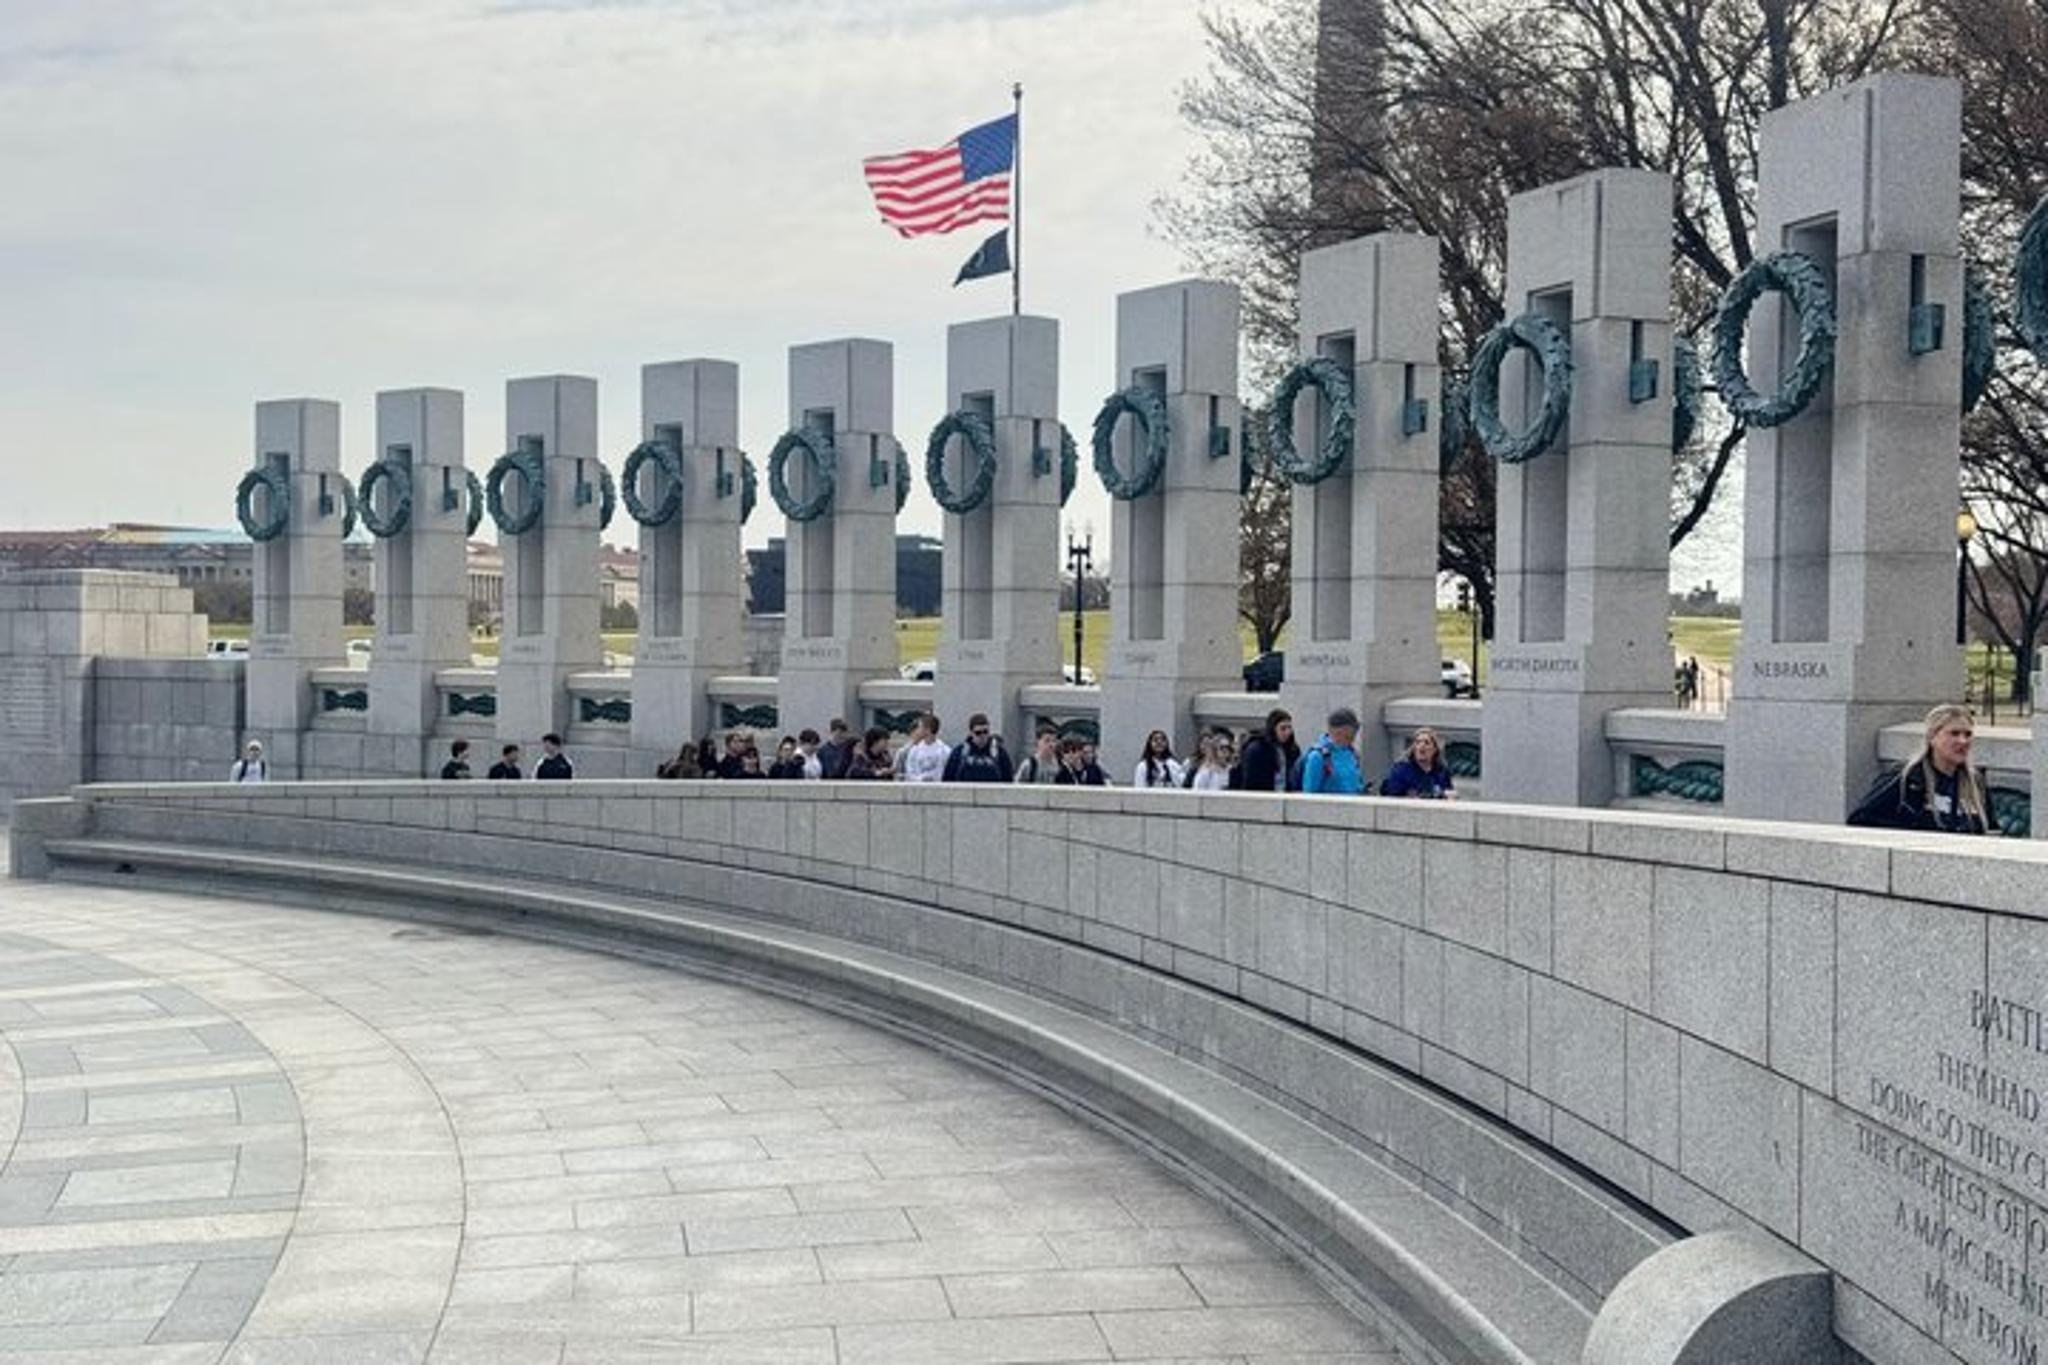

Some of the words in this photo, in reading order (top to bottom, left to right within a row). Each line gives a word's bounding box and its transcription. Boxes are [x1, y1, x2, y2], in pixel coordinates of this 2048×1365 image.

[1753, 661, 1829, 679] NEBRASKA
[1871, 1077, 1932, 1132] DOING
[1937, 1108, 1964, 1146] SO
[1967, 1122, 2020, 1174] THEY
[1937, 1052, 1987, 1100] THEY
[1991, 1073, 2040, 1122] HAD
[1855, 1123, 1890, 1166] THE
[1894, 1145, 1987, 1221] GREATEST
[1994, 1200, 2023, 1240] OF
[1895, 1201, 1909, 1232] A
[1914, 1209, 1978, 1275] MAGIC
[1925, 1271, 1969, 1321] MEN
[1977, 1306, 2037, 1365] FROM
